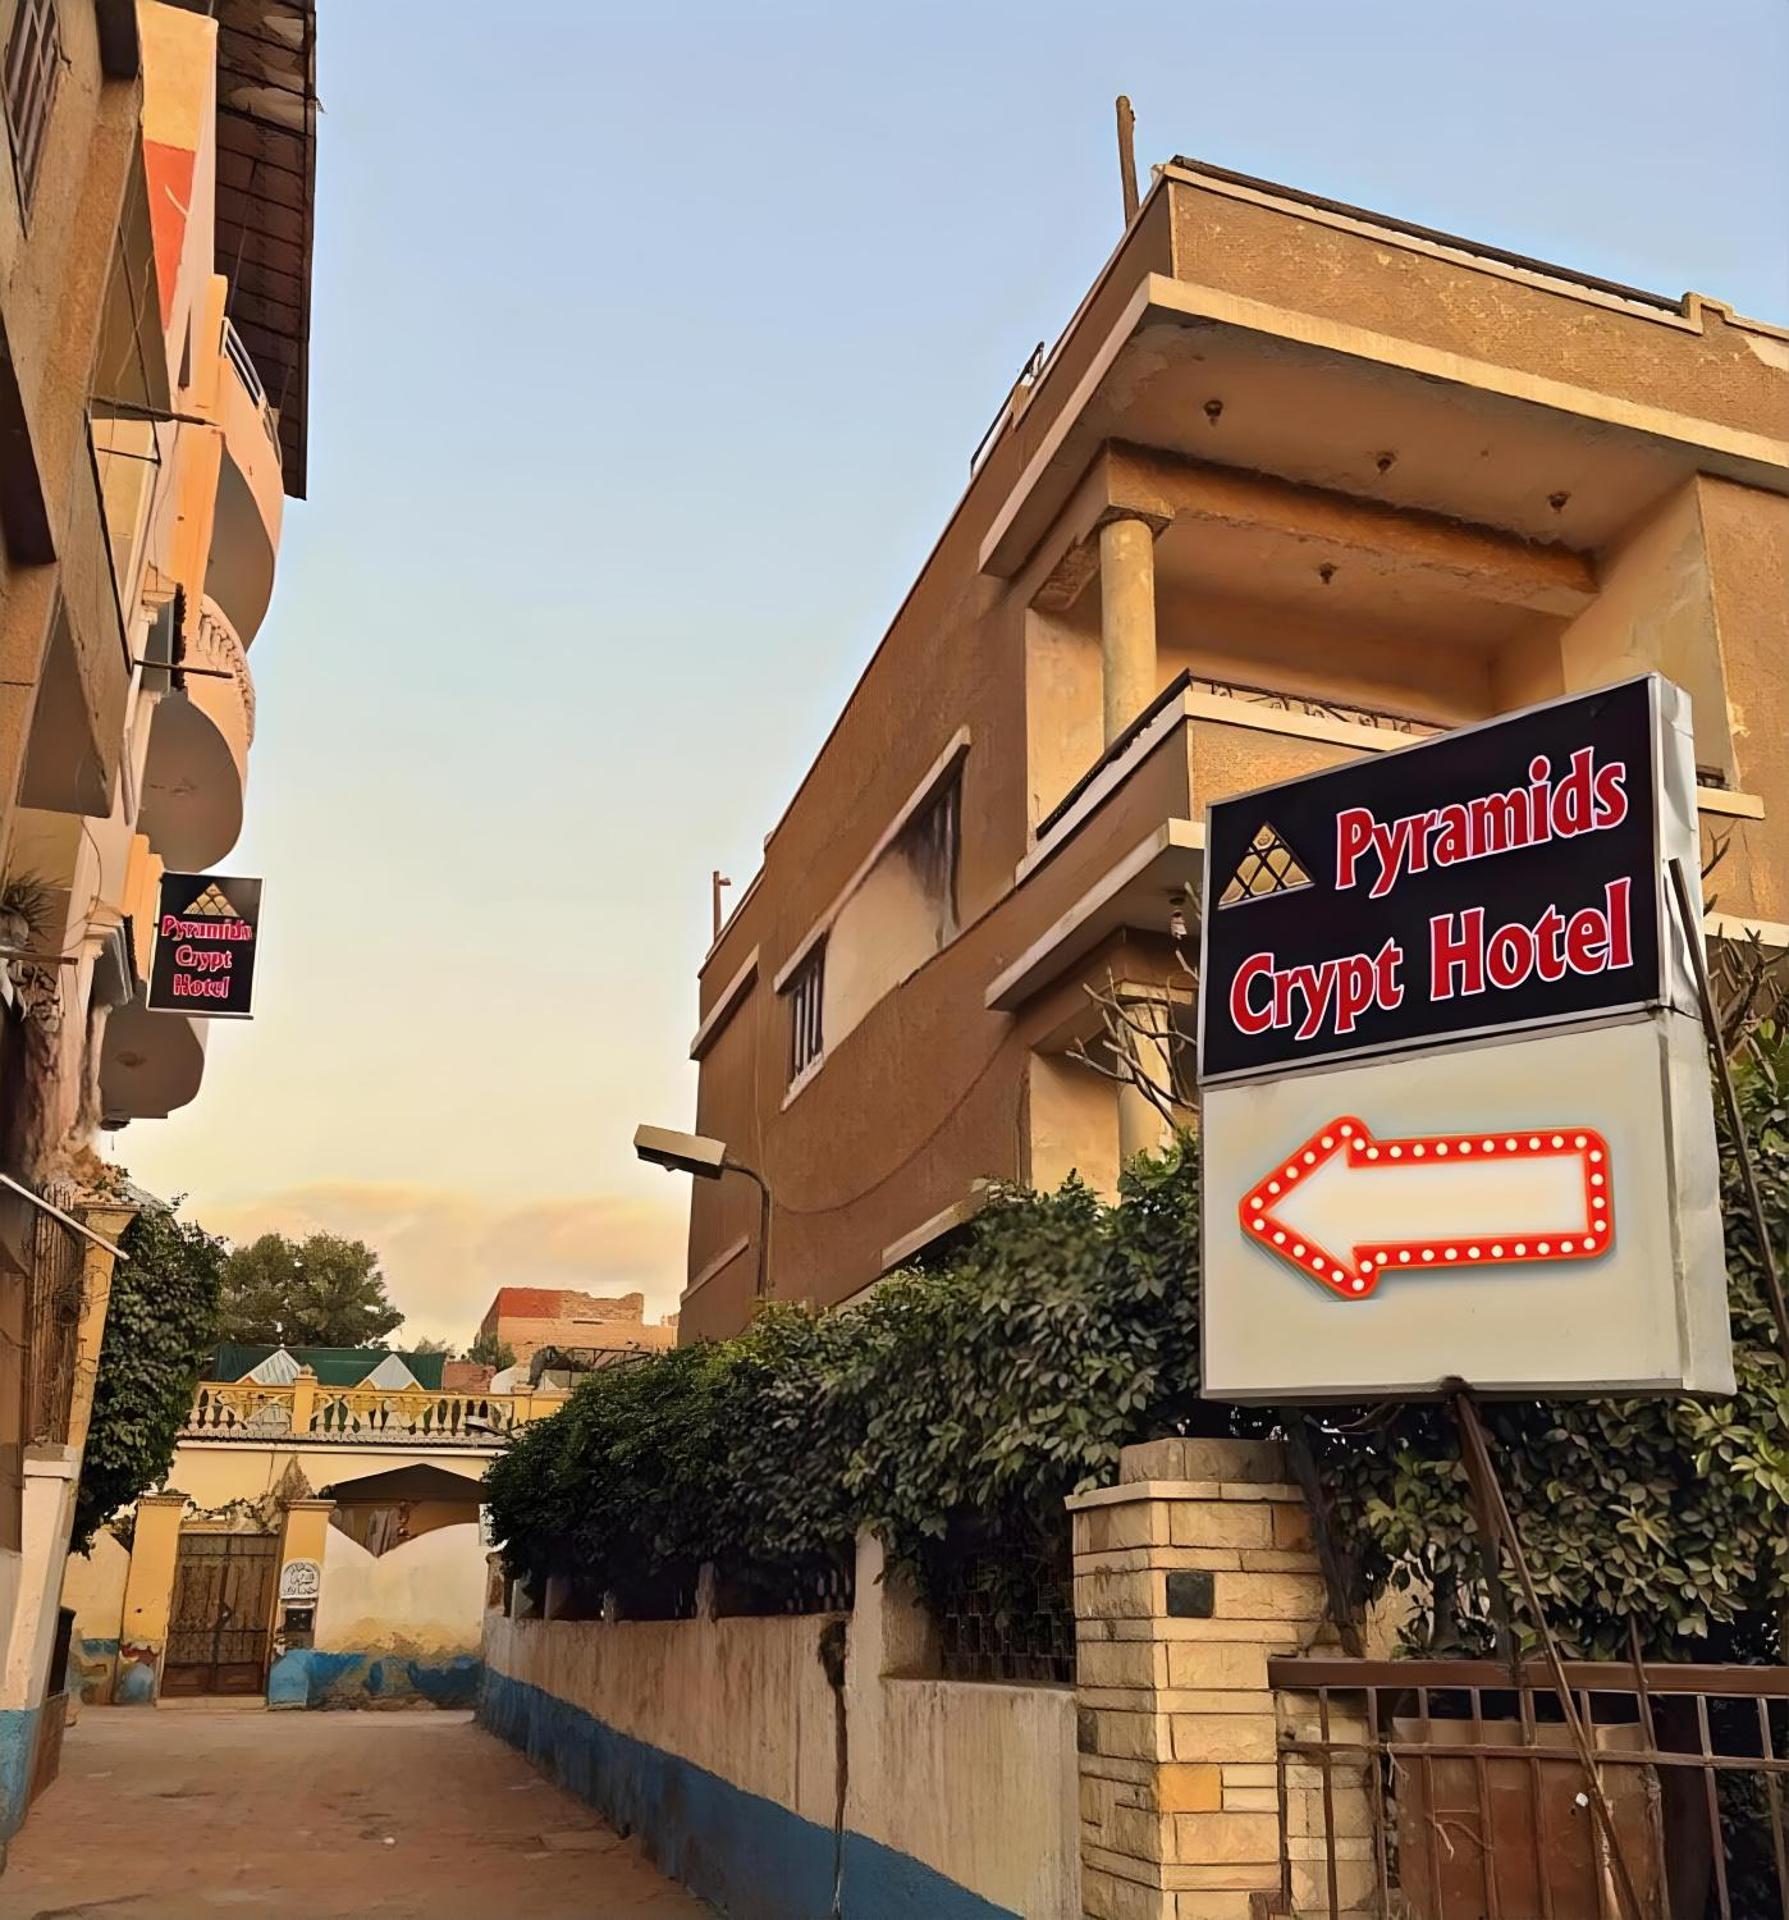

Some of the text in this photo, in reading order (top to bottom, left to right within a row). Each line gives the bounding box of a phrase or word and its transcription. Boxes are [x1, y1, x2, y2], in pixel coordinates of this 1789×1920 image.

[1335, 746, 1628, 898] Pyramids
[173, 973, 231, 999] Hotel
[175, 945, 233, 972] Crypt
[1229, 876, 1635, 1039] Crypt Hotel
